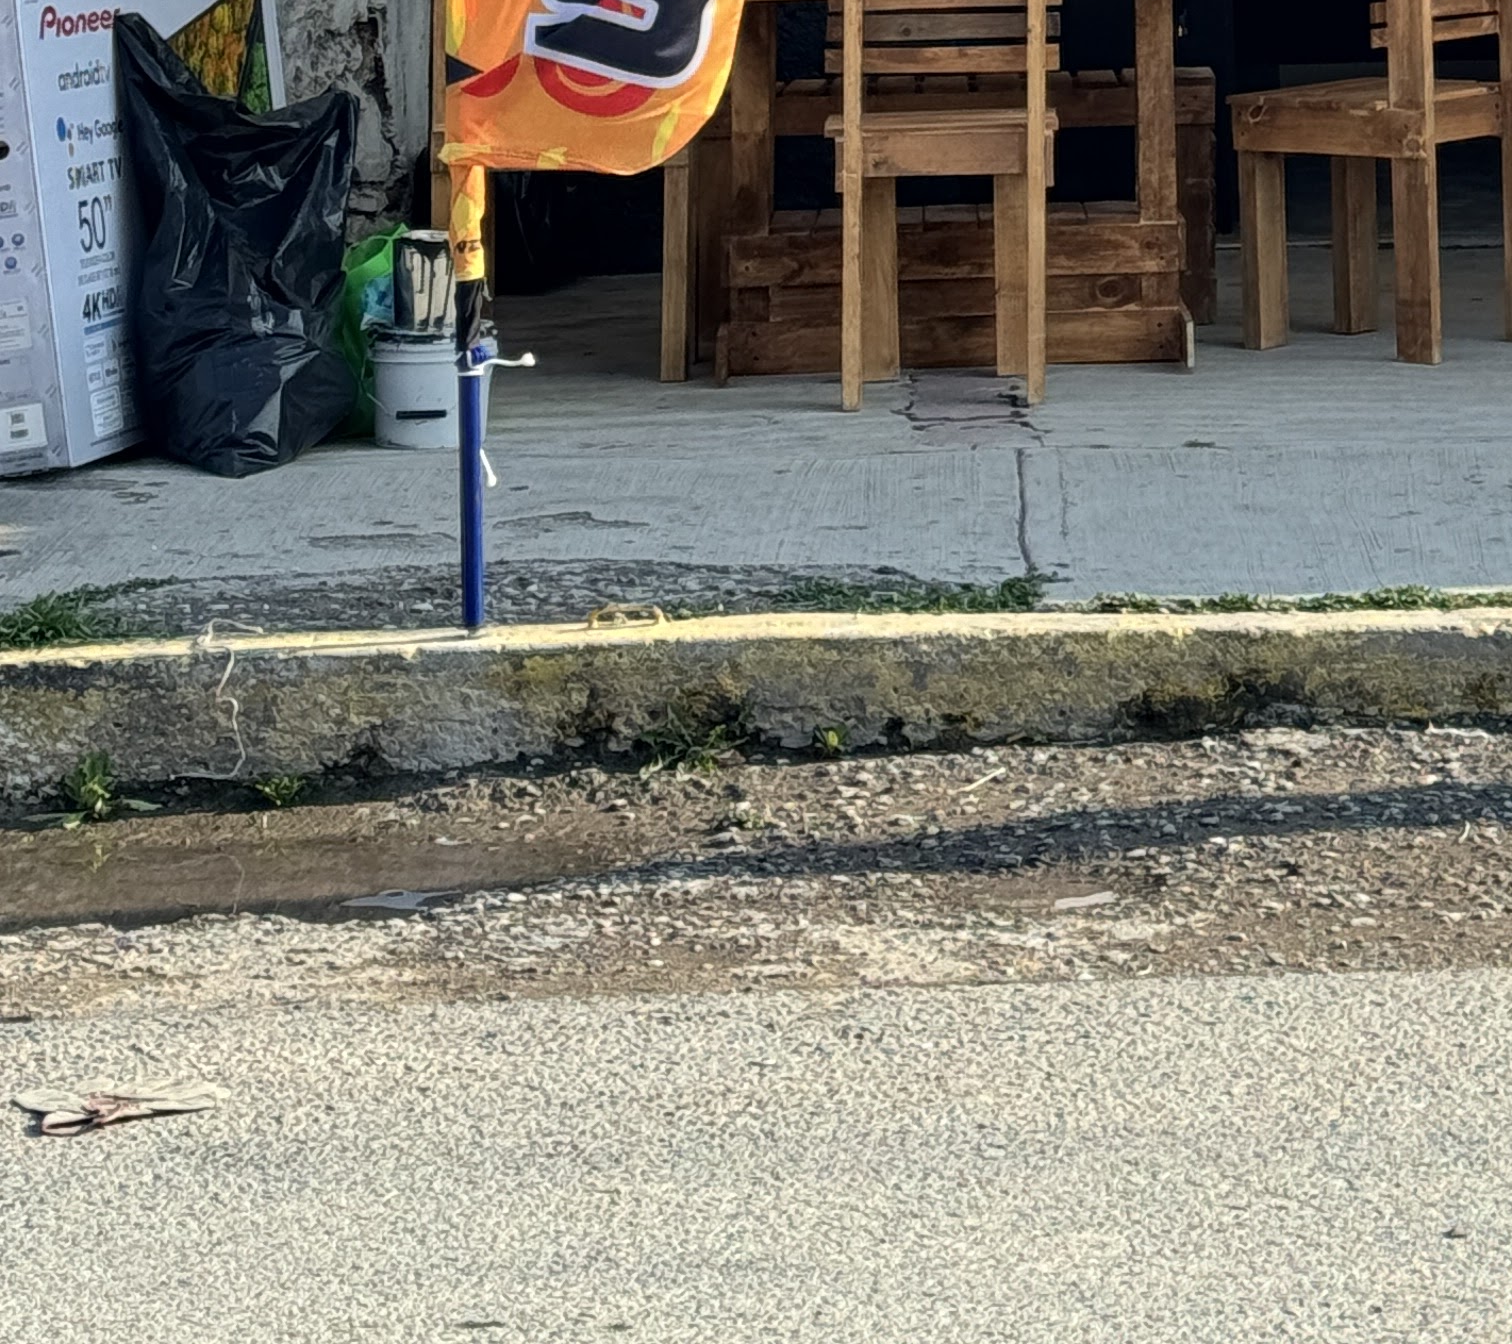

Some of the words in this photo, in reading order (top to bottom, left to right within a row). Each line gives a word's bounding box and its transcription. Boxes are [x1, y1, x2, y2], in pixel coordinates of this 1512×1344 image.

[39, 5, 121, 40] Pioneer
[67, 159, 105, 190] SMART
[107, 155, 122, 180] TV
